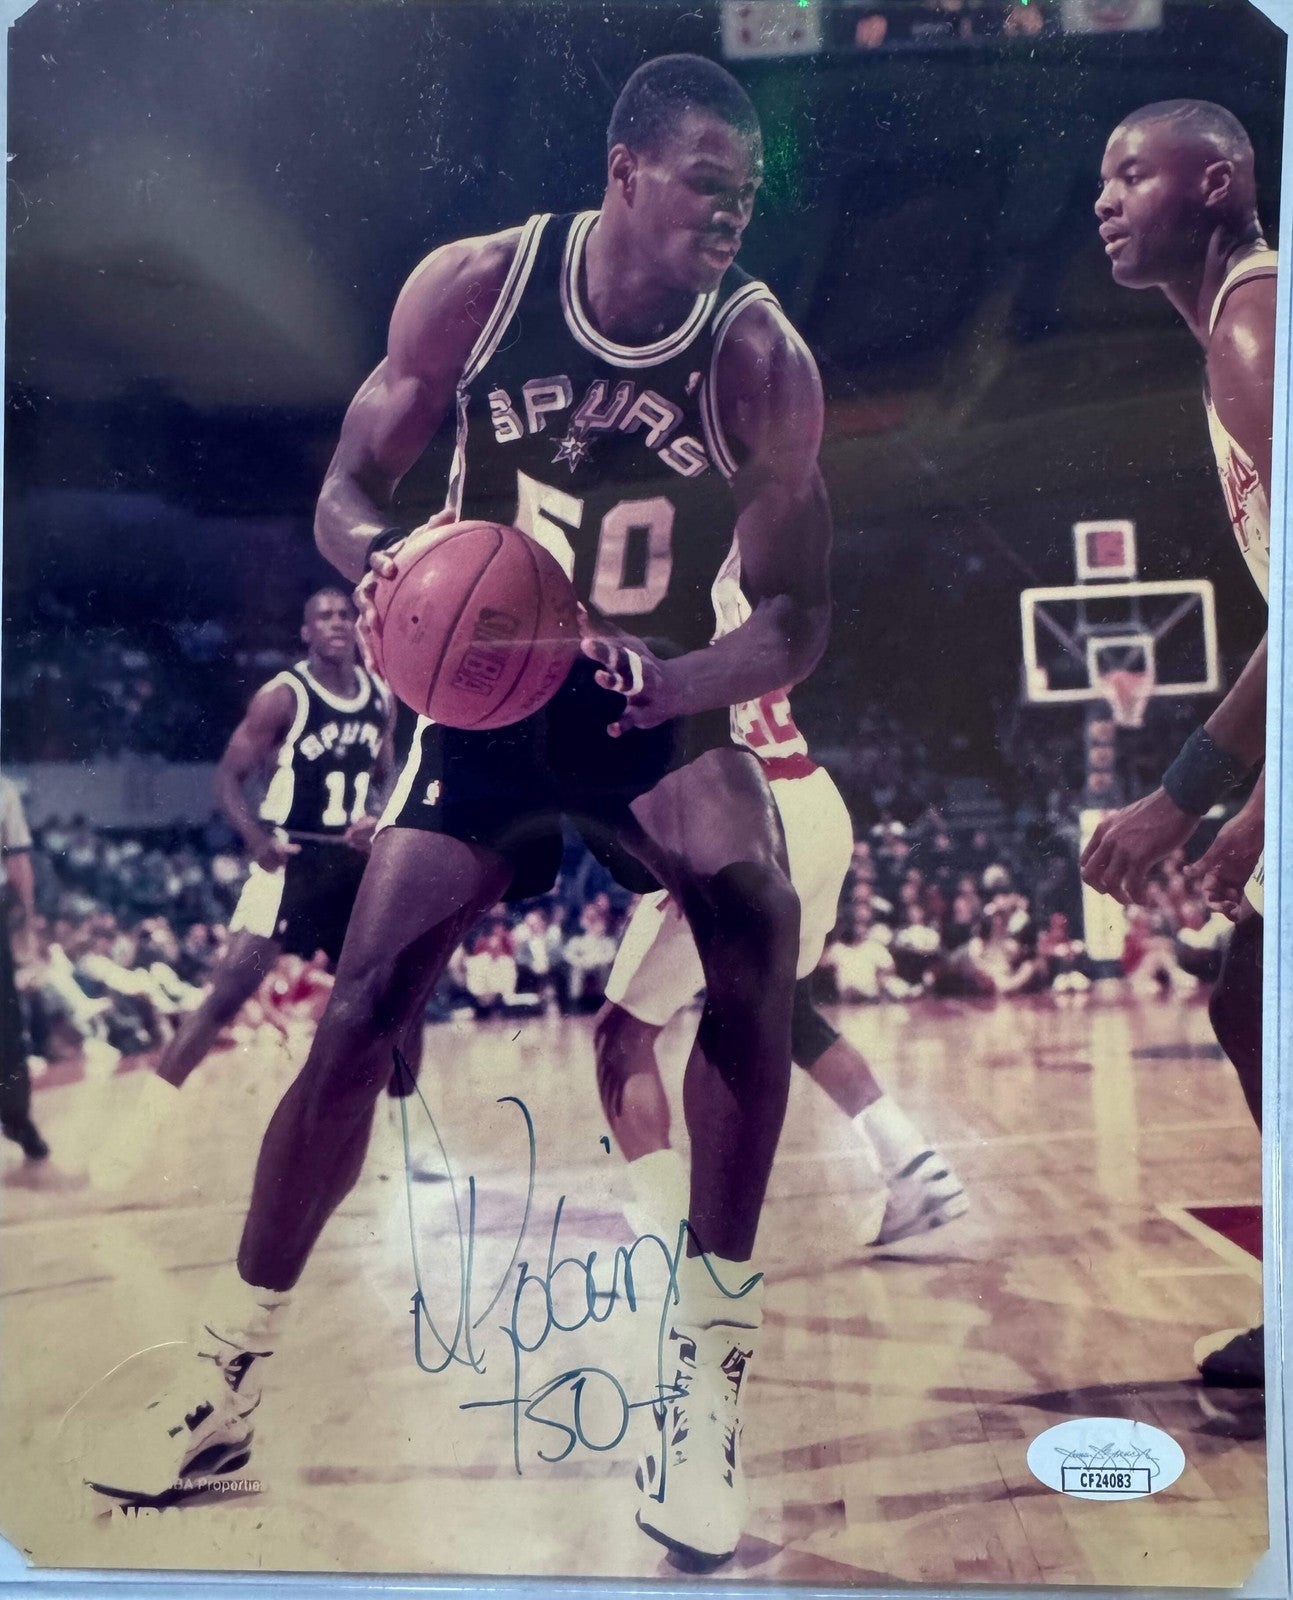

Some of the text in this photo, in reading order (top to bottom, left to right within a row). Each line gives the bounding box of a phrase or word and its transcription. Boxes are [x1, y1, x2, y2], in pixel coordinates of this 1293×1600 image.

[487, 375, 711, 478] SPURS
[512, 468, 676, 616] 50
[300, 720, 381, 761] SPUR
[322, 771, 370, 826] 11
[1080, 1472, 1132, 1489] CF24083
